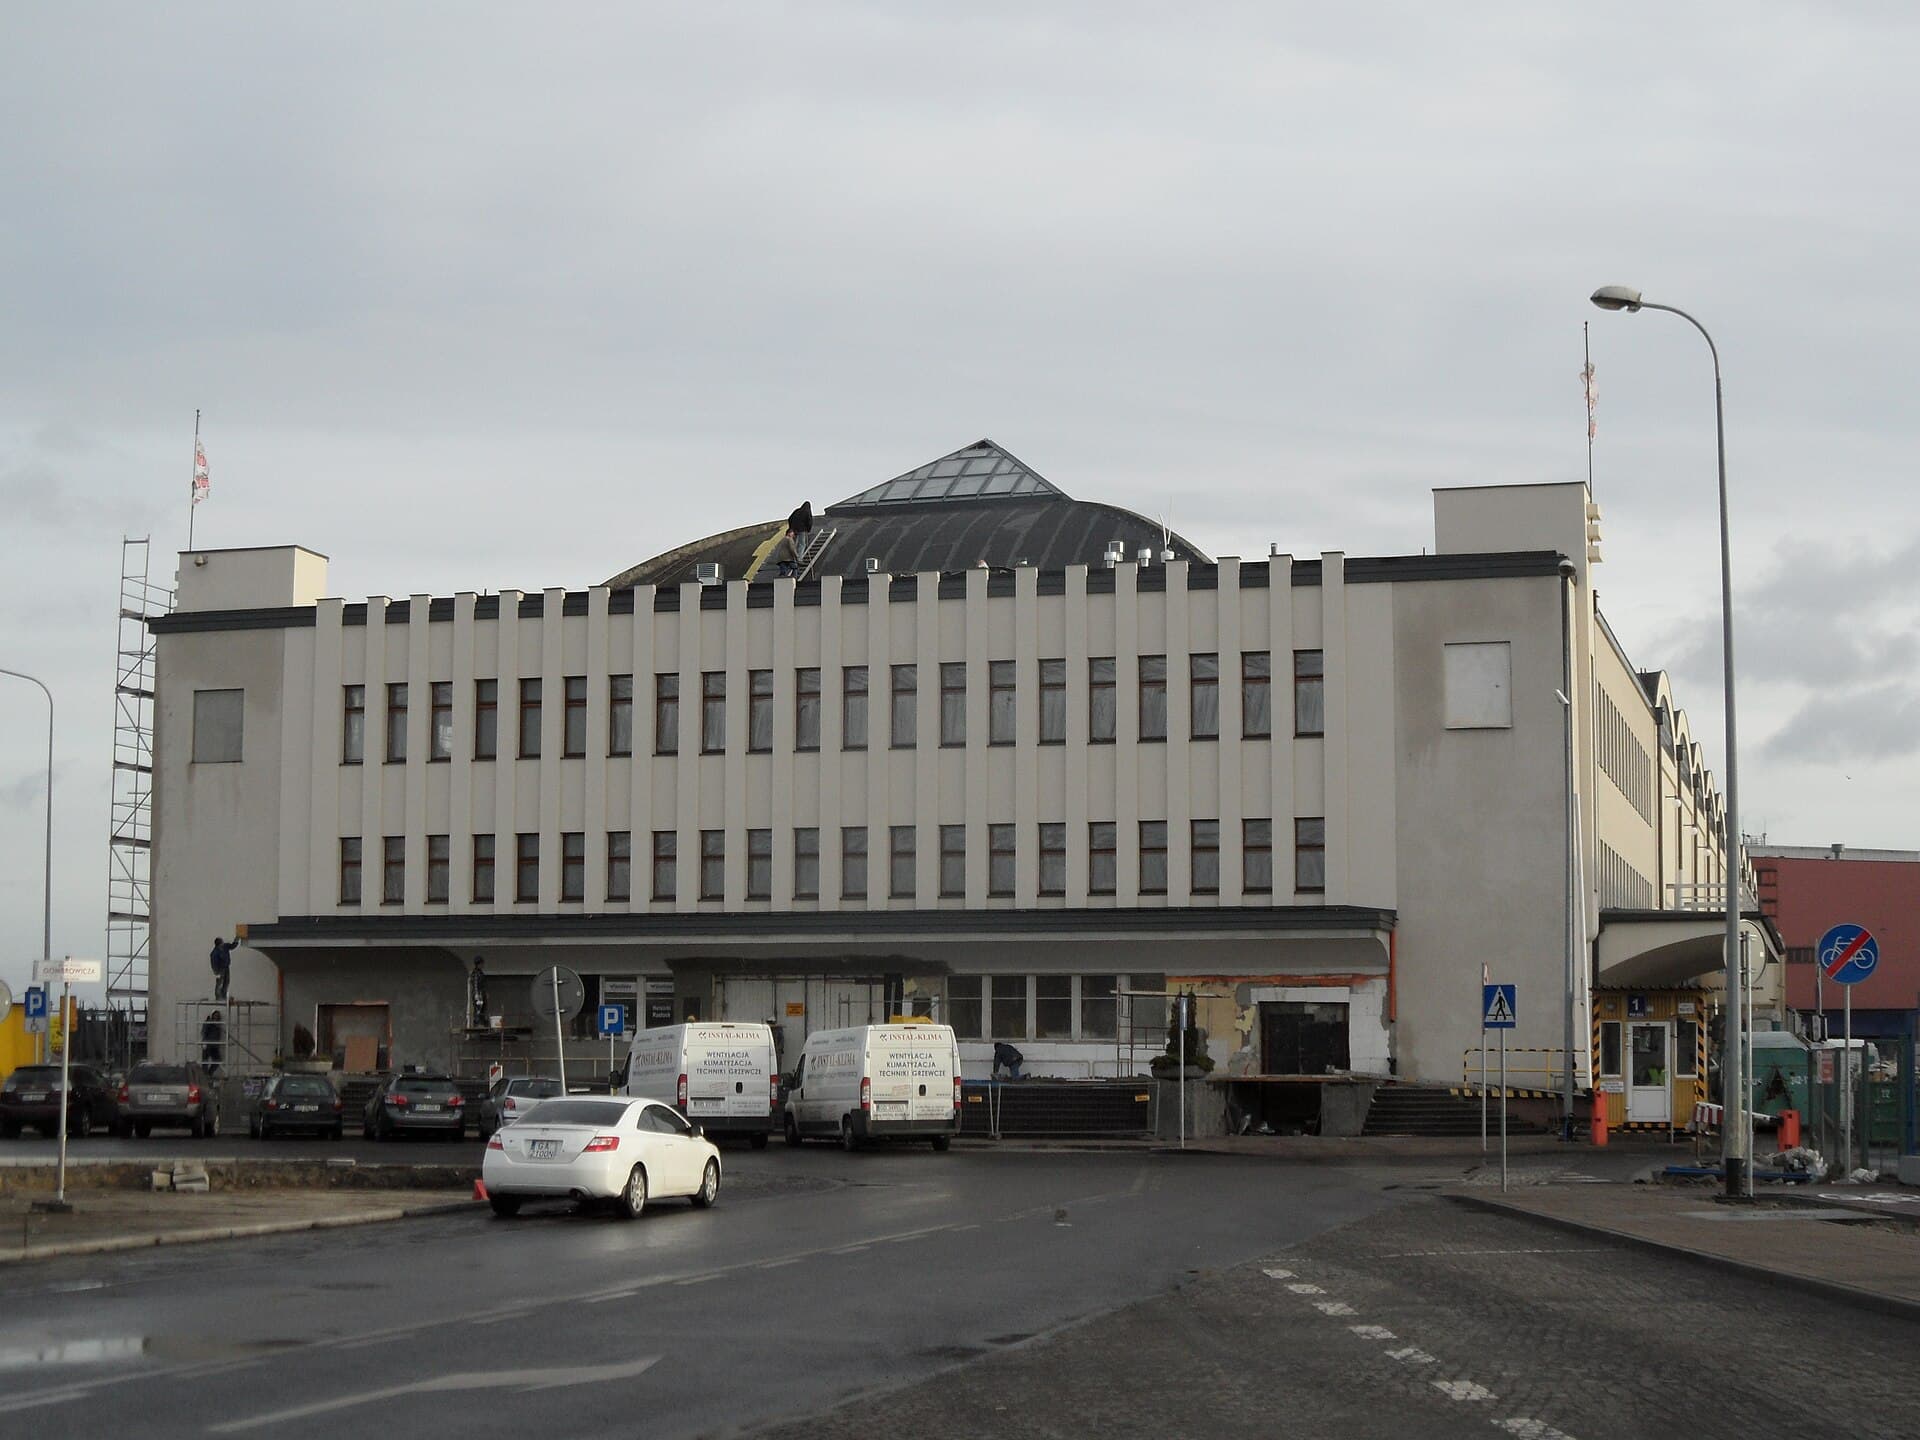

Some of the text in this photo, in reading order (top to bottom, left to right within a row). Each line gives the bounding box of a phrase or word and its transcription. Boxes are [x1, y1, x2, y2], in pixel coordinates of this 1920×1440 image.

[30, 994, 43, 1015] P
[1632, 998, 1640, 1011] 1
[604, 1008, 619, 1030] P
[708, 1032, 761, 1040] INSTAL-KLIMA
[889, 1033, 943, 1041] INSTAL-KLIMA
